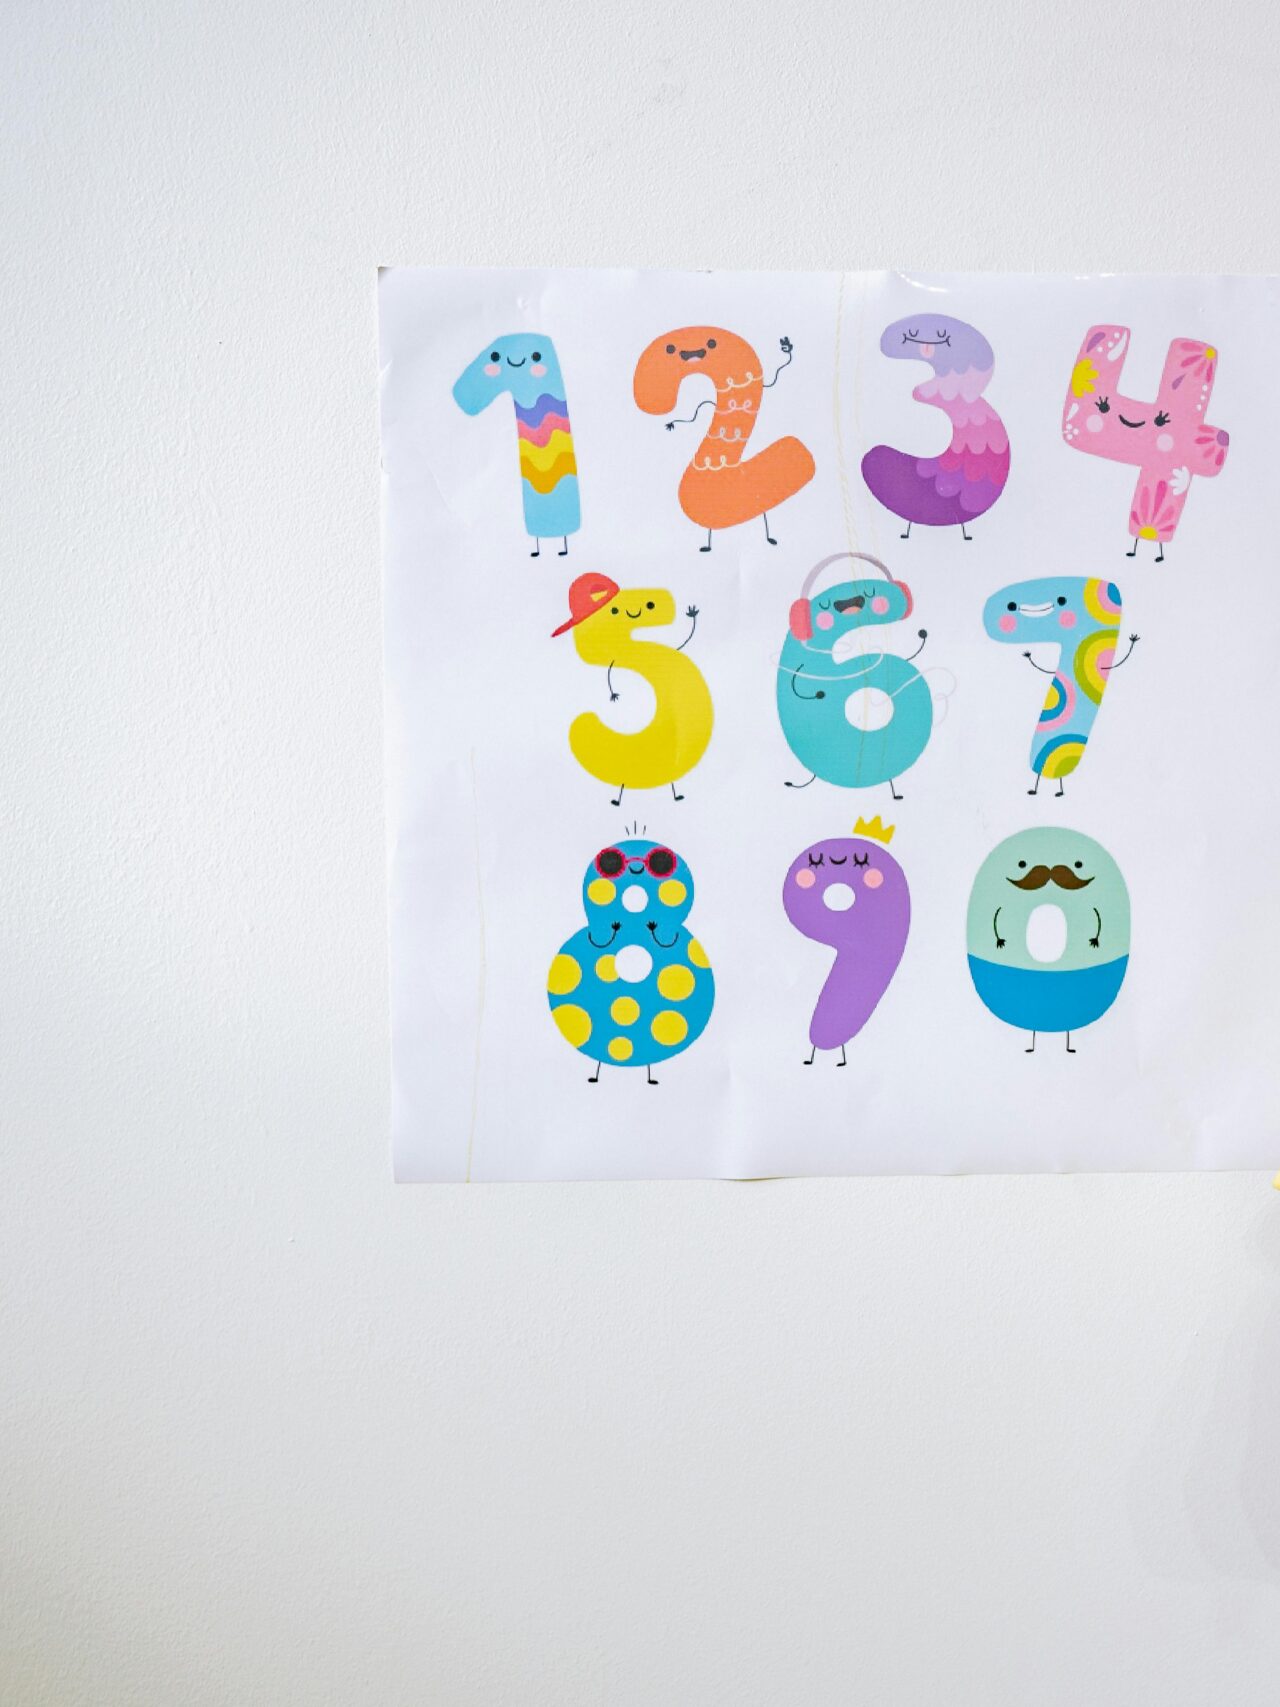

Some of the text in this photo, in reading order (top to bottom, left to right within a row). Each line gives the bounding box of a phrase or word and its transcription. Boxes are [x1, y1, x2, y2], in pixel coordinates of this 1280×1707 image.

[452, 313, 1231, 542] 1 2 3 4
[569, 576, 1122, 789] 5 6 7
[547, 826, 1131, 1067] 8 9 0
